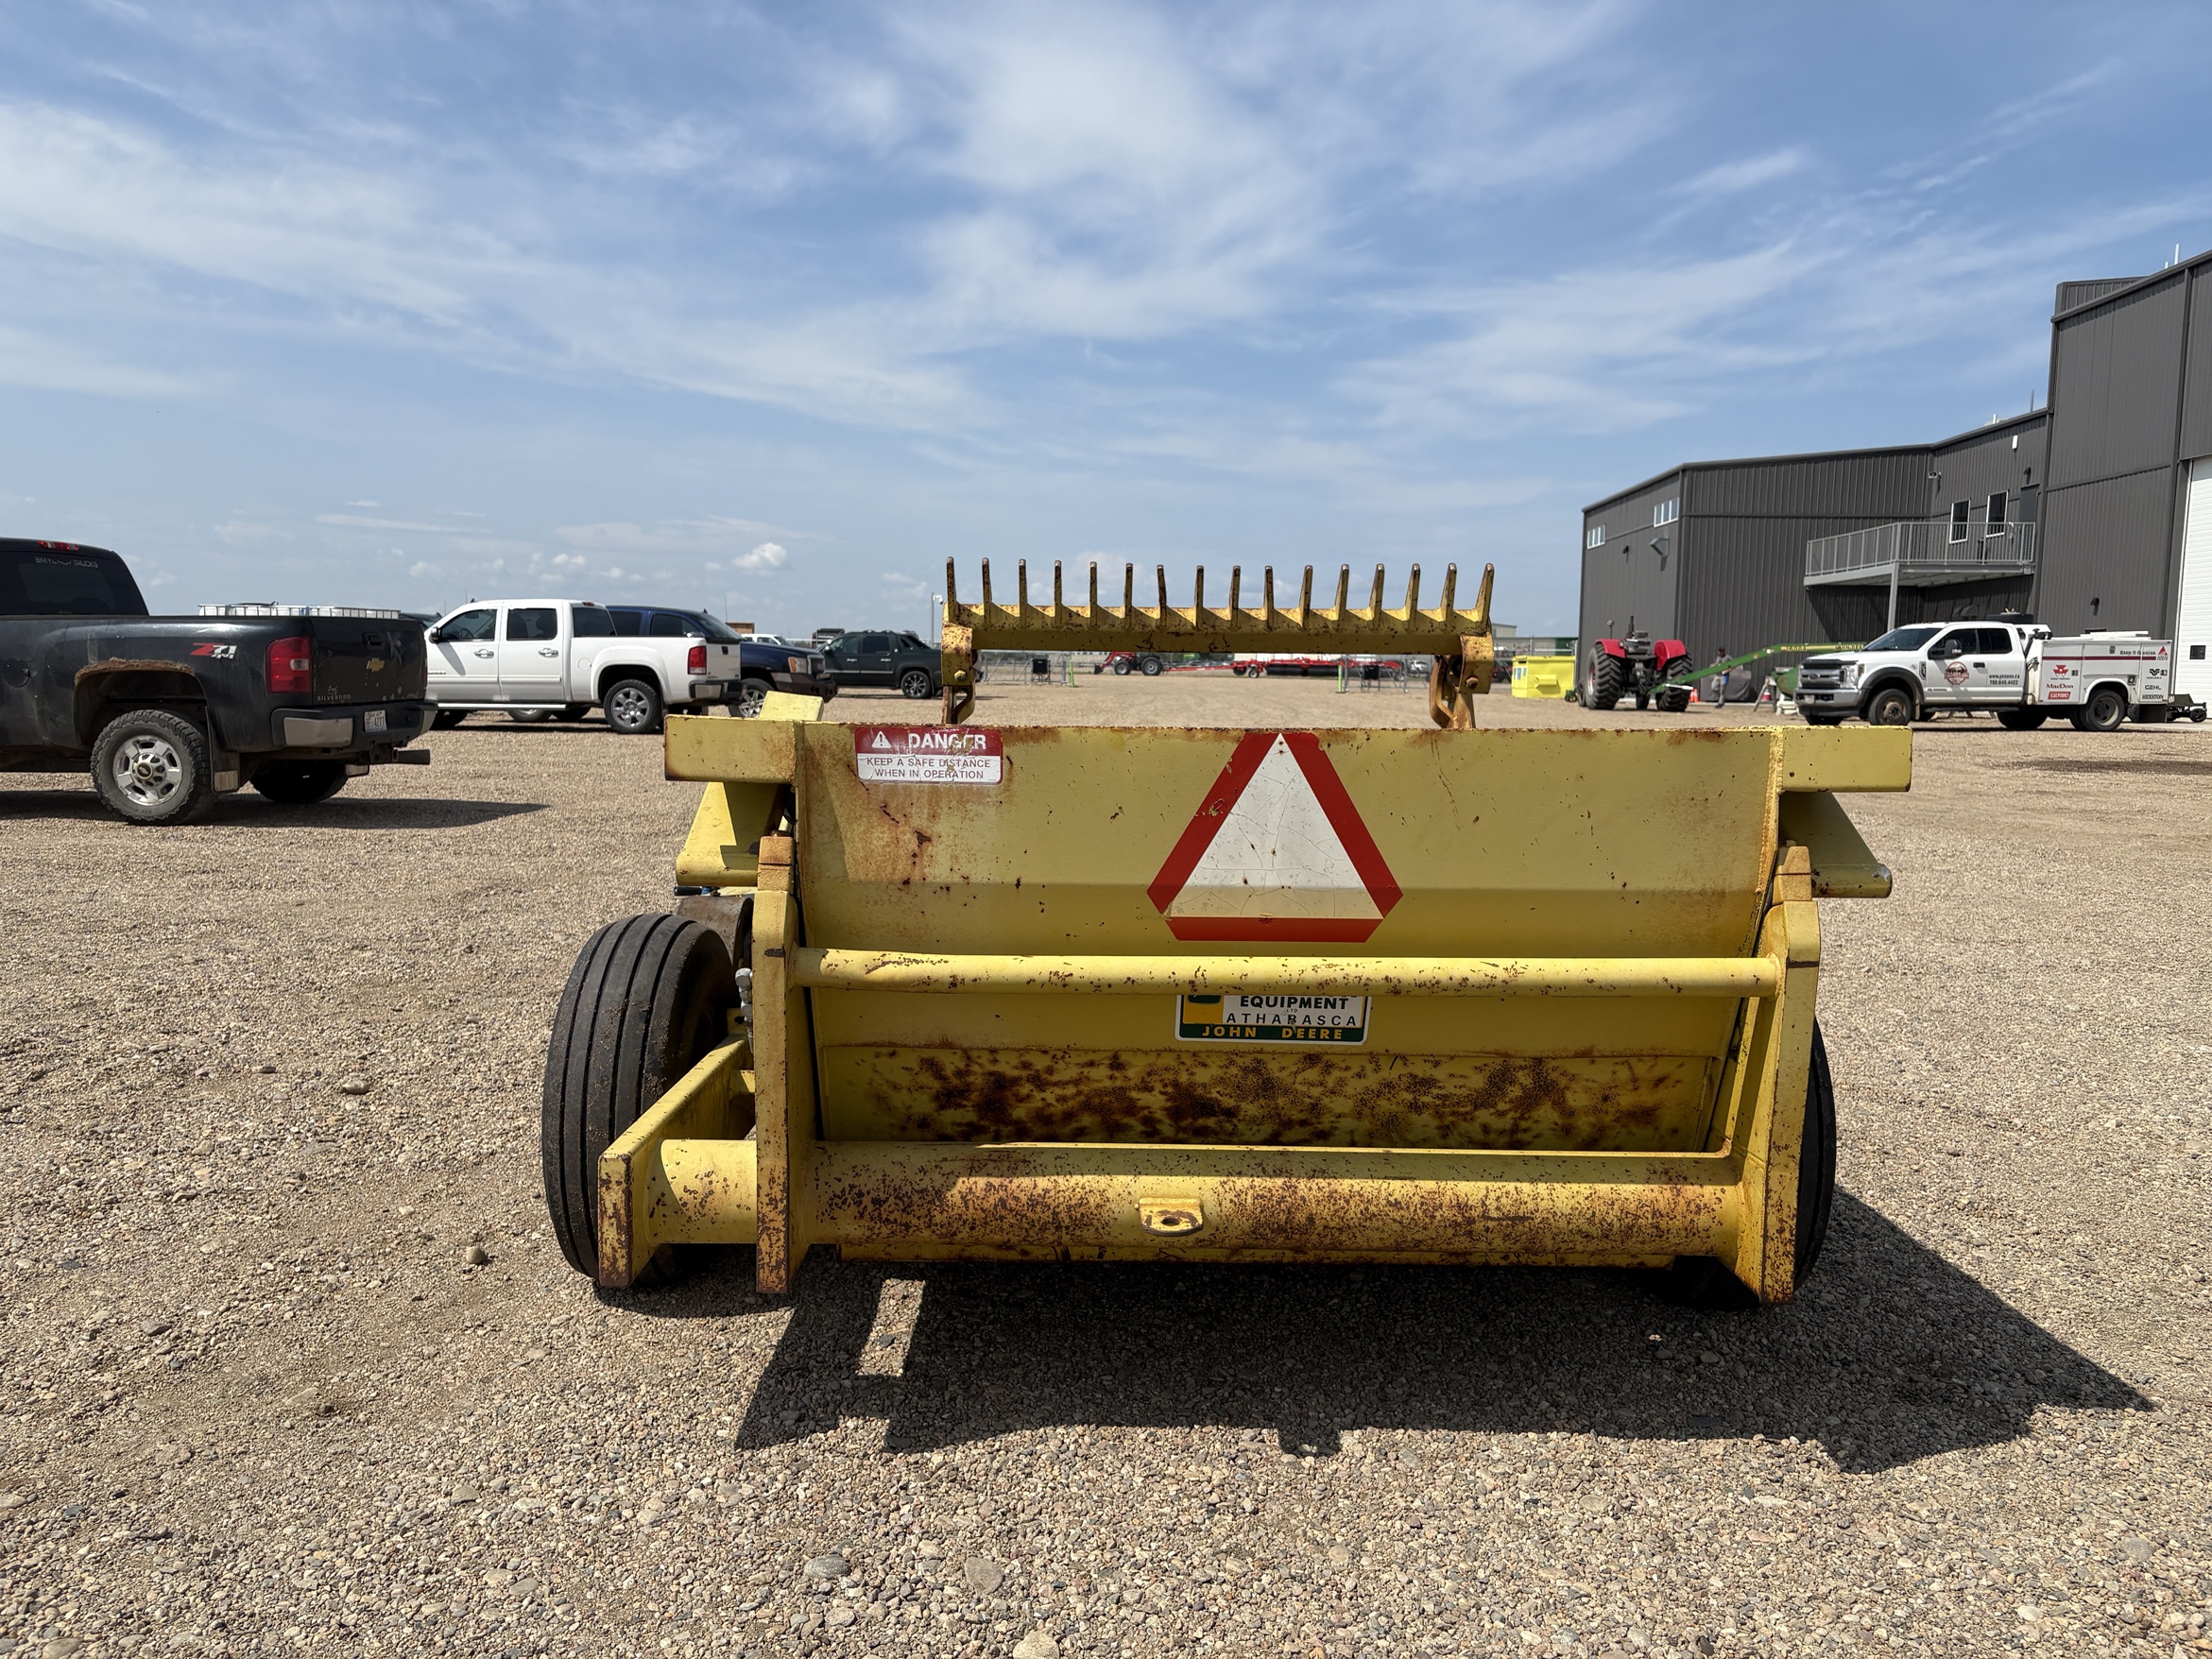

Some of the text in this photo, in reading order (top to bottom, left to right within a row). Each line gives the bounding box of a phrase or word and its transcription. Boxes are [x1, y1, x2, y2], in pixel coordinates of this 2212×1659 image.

[73, 559, 99, 569] TRUCKS
[191, 642, 237, 657] Z71
[866, 757, 990, 768] KEEP A SAFE DISTANCE
[875, 768, 984, 779] WHEN IN OPERATION
[1240, 995, 1349, 1010] EQUIPMENT
[1226, 1013, 1357, 1027] ATHABASCA
[1202, 1026, 1343, 1039] JOHN DEERE
